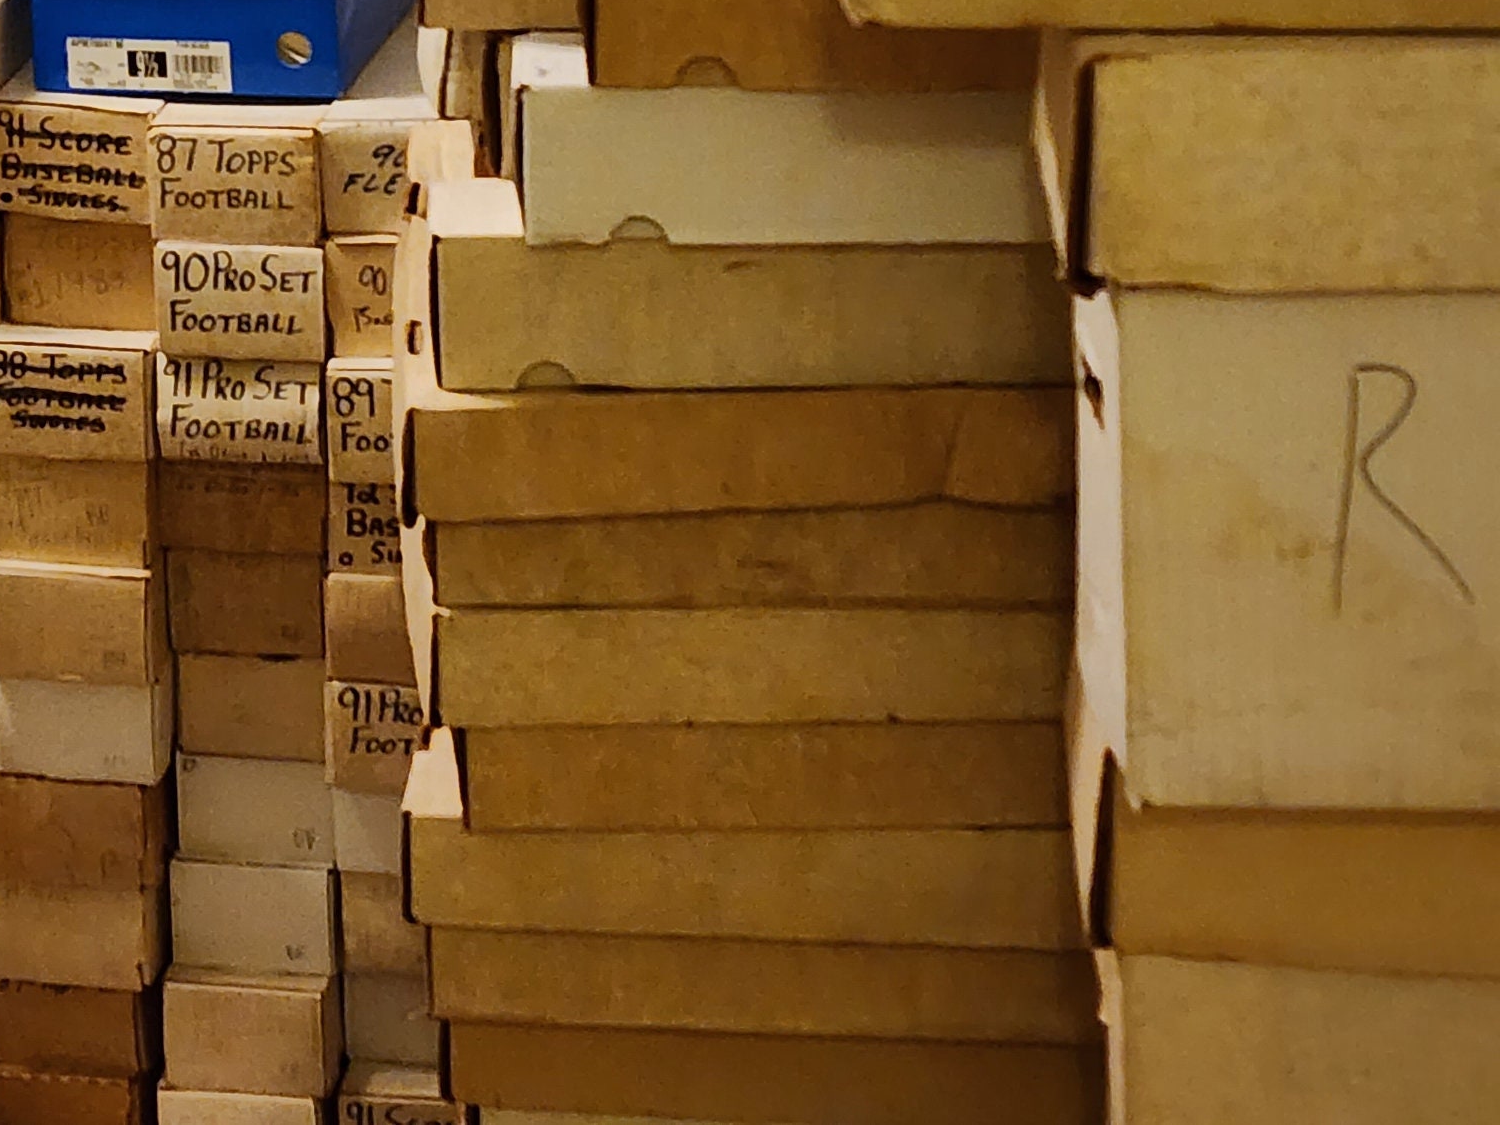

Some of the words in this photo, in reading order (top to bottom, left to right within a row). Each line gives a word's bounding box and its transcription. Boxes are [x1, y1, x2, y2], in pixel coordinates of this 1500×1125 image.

[37, 114, 134, 156] SCORE
[156, 134, 197, 173] 87
[208, 139, 297, 177] TOPPS
[1, 152, 148, 190] BASEBALL
[159, 185, 294, 211] FOOTBALL
[160, 250, 209, 294] 90
[211, 249, 257, 293] PRO
[258, 260, 318, 295] SET
[169, 298, 304, 336] FOOTBALL
[163, 358, 193, 398] 91
[201, 357, 247, 402] PRO
[251, 364, 319, 406] SET
[332, 376, 376, 418] 89
[169, 402, 314, 446] FOOTBALL
[1334, 363, 1476, 622] R
[337, 686, 372, 725] 91
[376, 688, 425, 726] PRO
